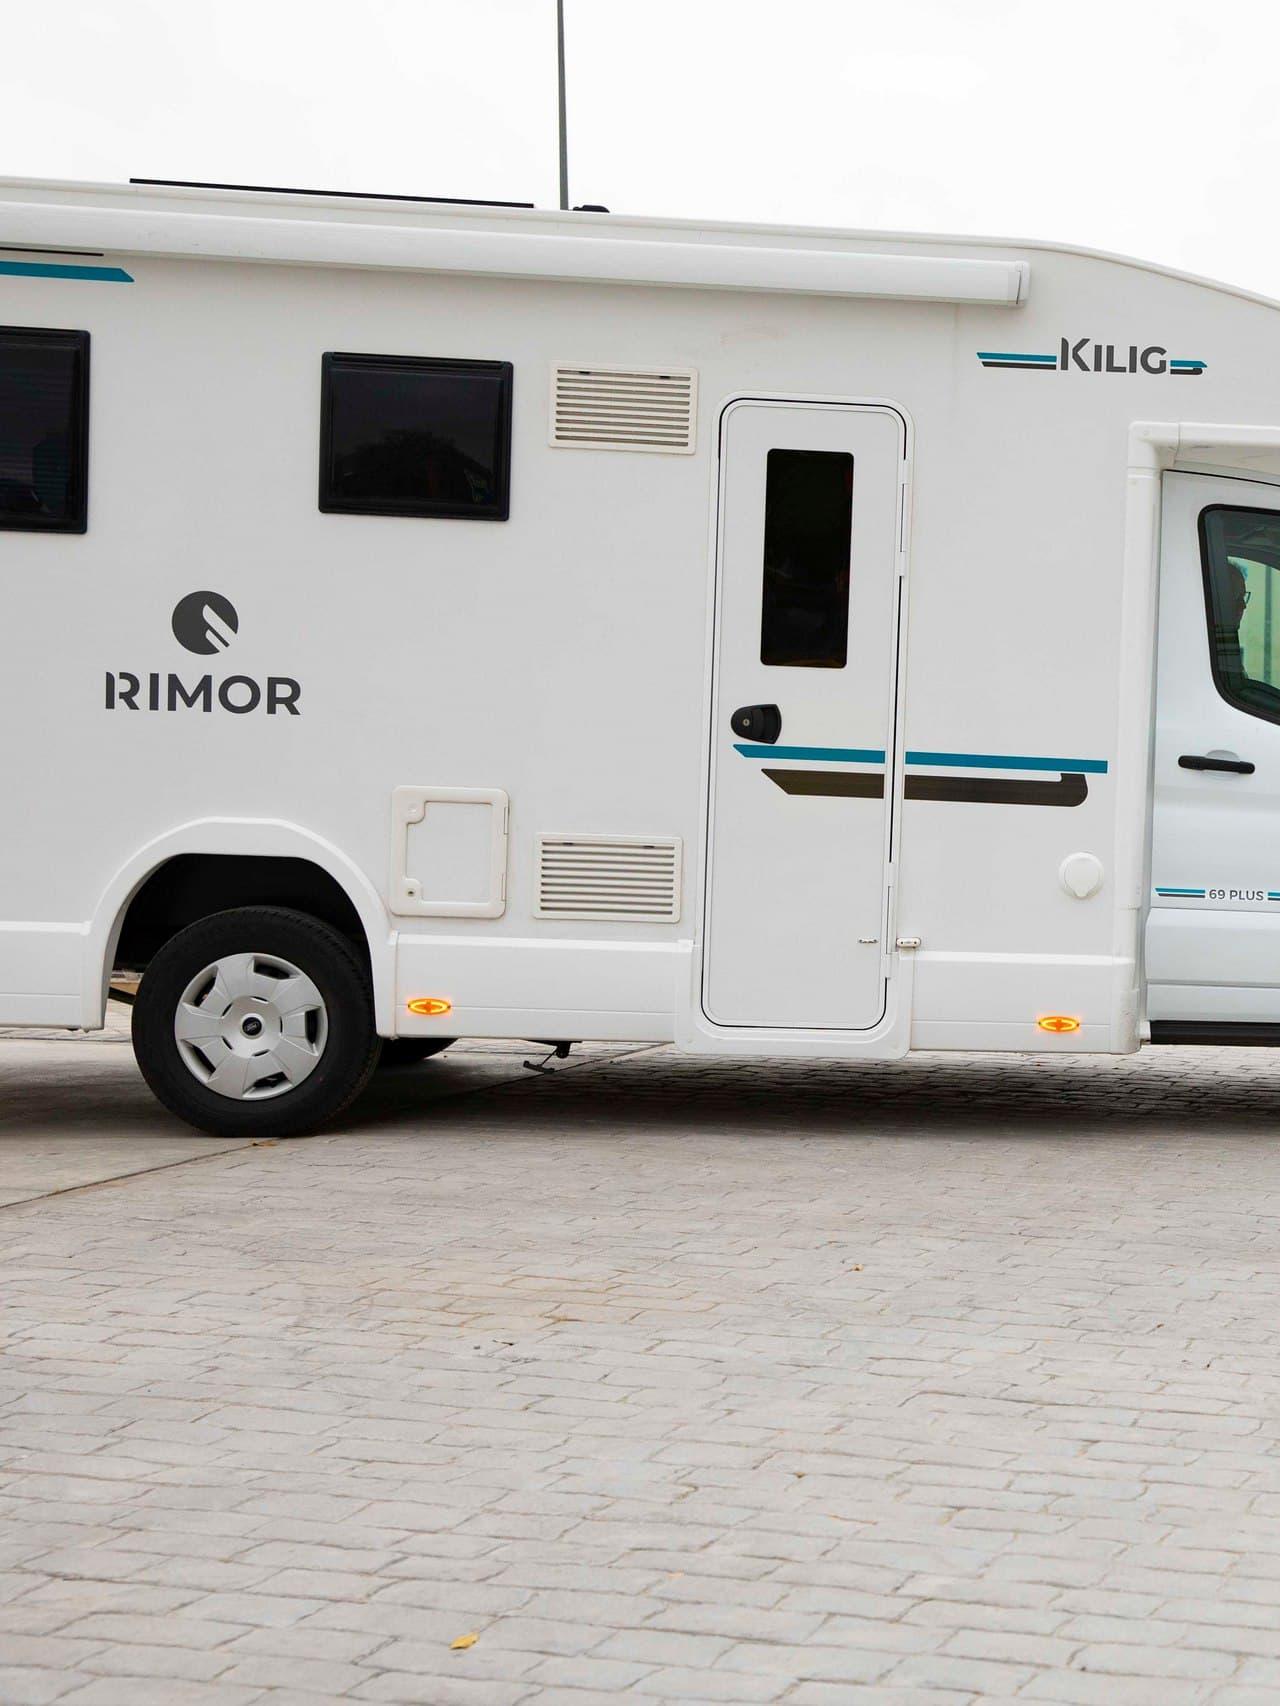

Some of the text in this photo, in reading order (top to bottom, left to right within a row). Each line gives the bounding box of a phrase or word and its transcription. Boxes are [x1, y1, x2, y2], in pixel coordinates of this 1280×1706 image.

[1060, 337, 1167, 375] KILIG
[105, 671, 301, 716] RIMOR
[1209, 889, 1264, 901] 69 PLUS
